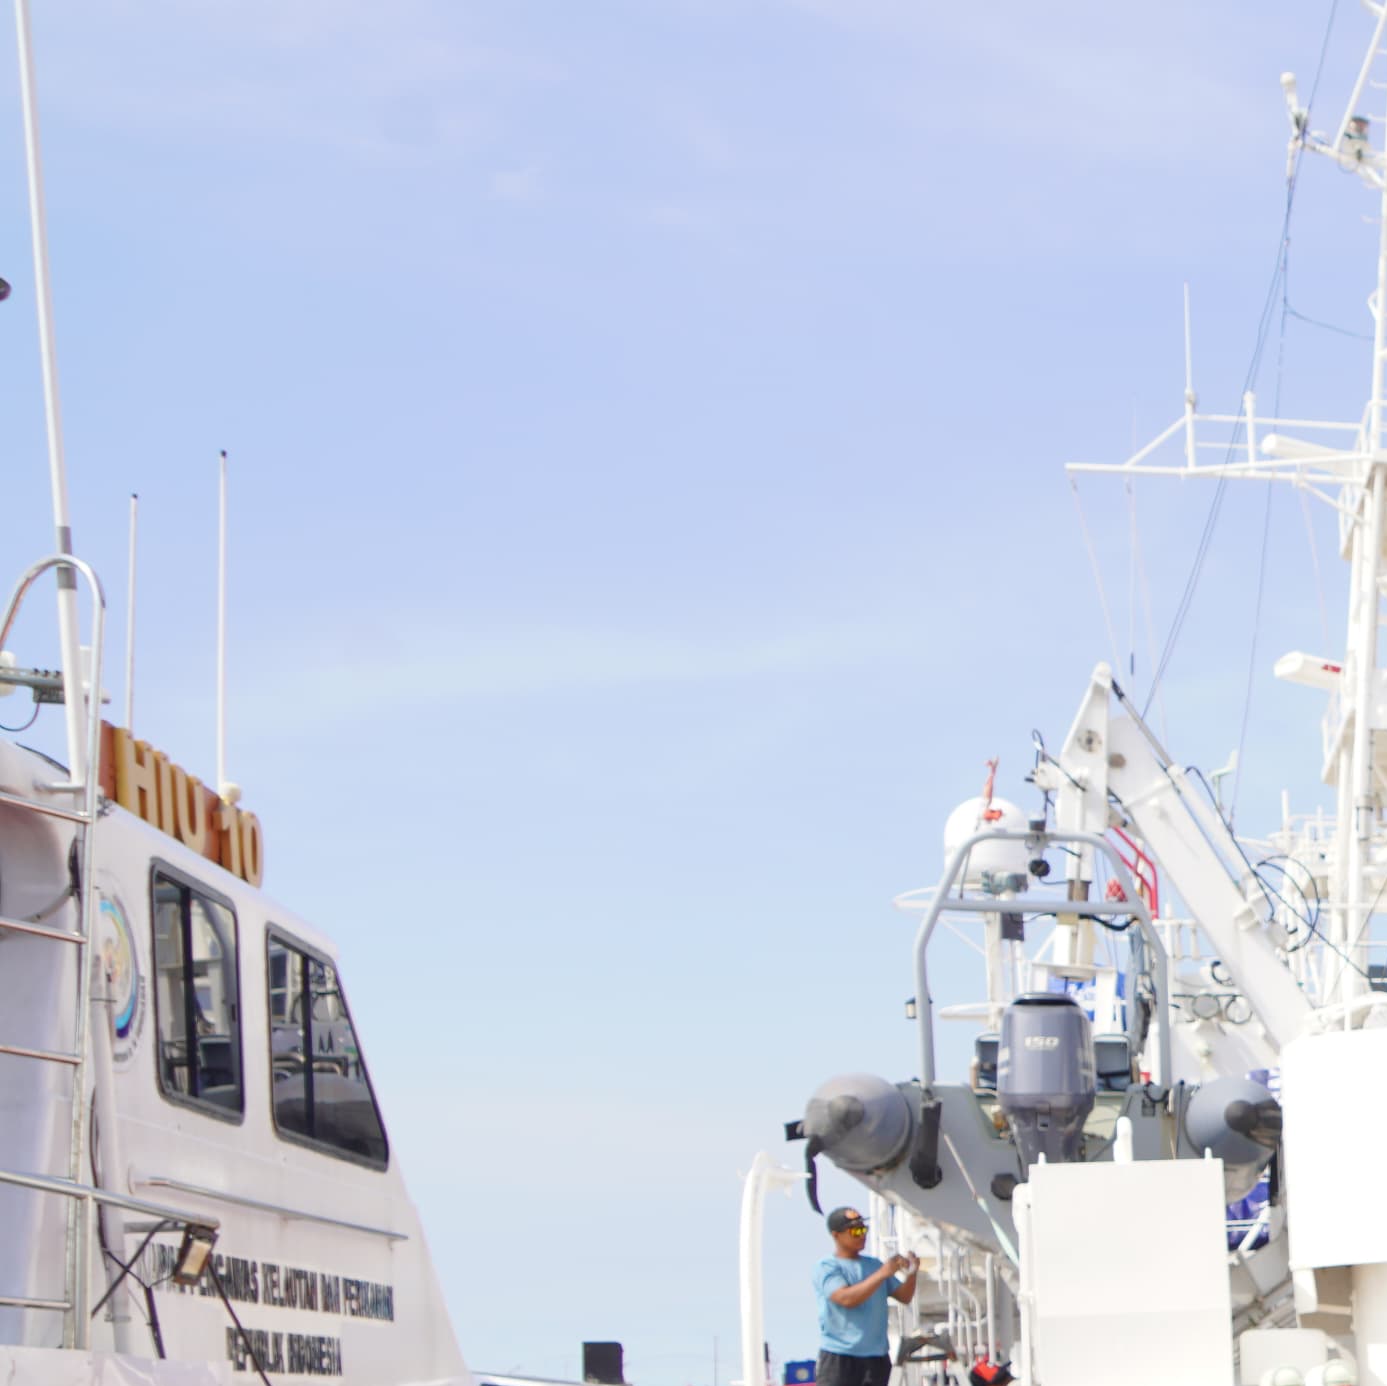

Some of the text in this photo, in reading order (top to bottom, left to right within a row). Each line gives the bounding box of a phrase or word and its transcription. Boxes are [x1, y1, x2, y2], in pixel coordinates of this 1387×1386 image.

[115, 728, 264, 889] HIU 10
[287, 1333, 343, 1376] INDONESIA
